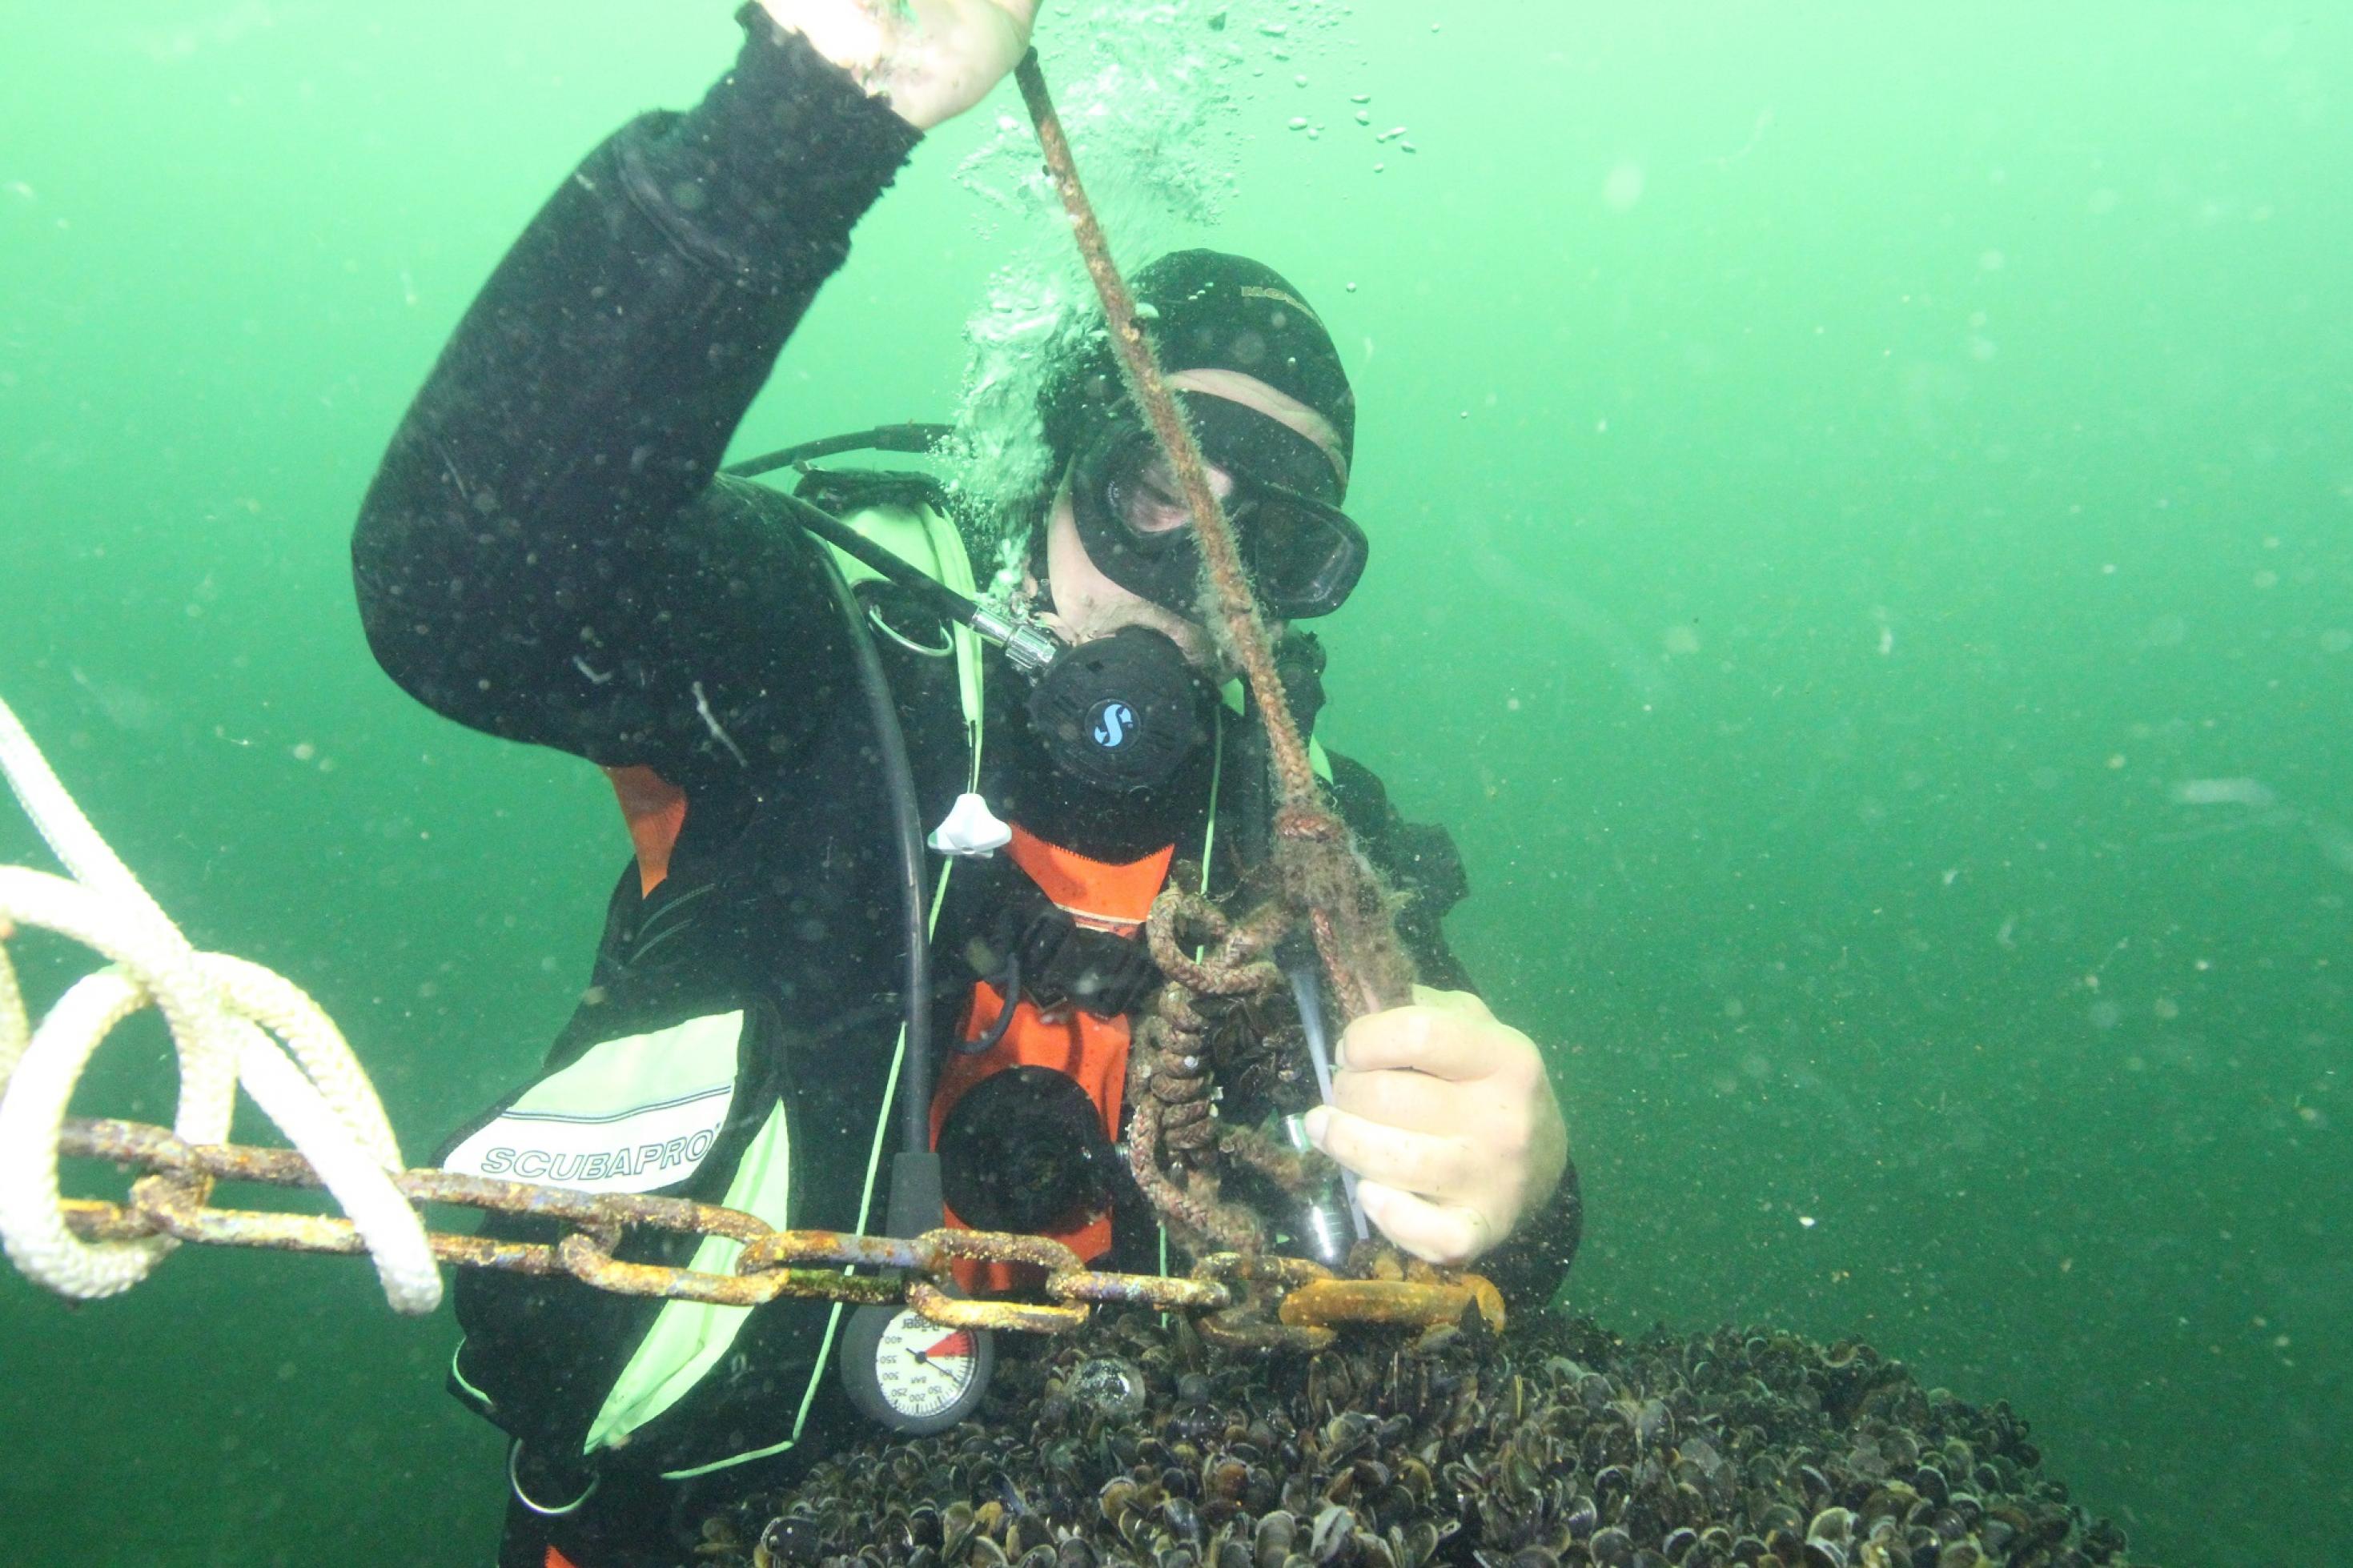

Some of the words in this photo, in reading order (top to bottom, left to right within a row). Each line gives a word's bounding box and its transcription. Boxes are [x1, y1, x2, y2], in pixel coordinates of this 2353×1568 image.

[481, 1129, 715, 1181] SCUBAPRO
[891, 1388, 907, 1397] 250
[909, 1394, 926, 1402] 200
